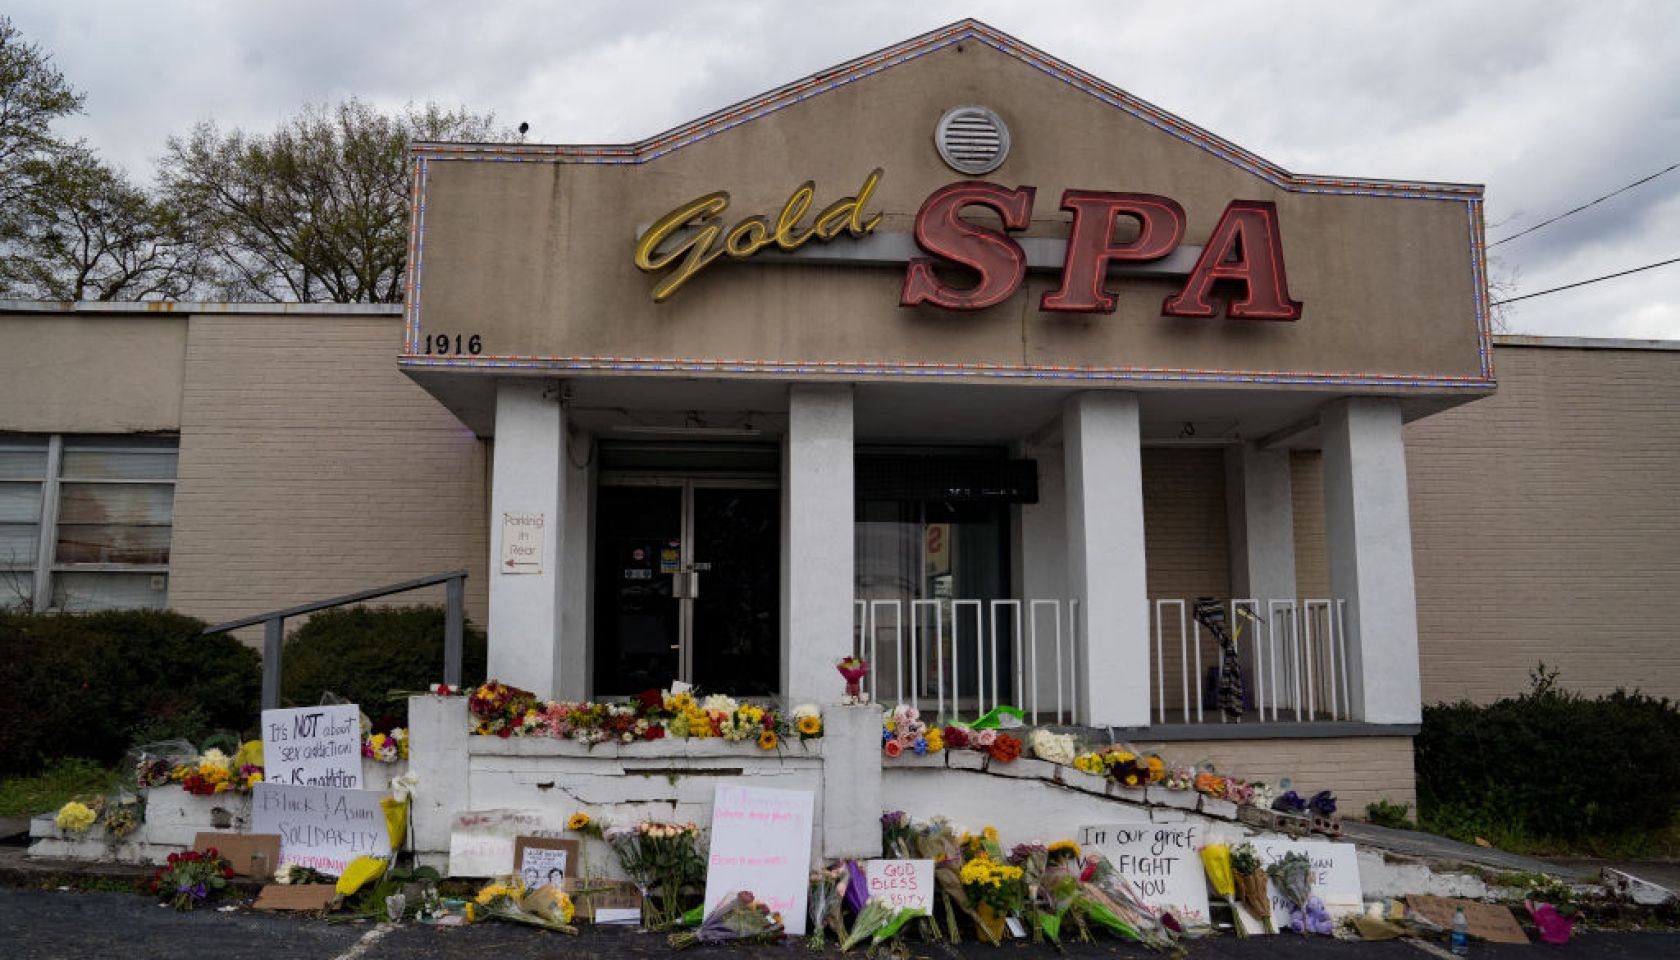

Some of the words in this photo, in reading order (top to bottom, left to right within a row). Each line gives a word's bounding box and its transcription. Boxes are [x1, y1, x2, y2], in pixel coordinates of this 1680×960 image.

[634, 167, 882, 302] Gold
[900, 180, 1304, 321] SPA
[425, 334, 482, 355] 1916
[504, 515, 544, 529] Parking
[510, 544, 537, 556] Rear
[269, 722, 288, 742] It's
[293, 713, 324, 740] NOT
[323, 715, 357, 737] about
[262, 789, 317, 812] Black
[333, 795, 376, 821] Asian
[279, 821, 378, 852] SOLIDARITY
[1081, 826, 1107, 846] In
[1116, 829, 1149, 845] our
[884, 863, 914, 876] GOD
[1119, 854, 1181, 877] FIGHT
[872, 877, 917, 889] BLESS
[1133, 879, 1166, 900] YOU
